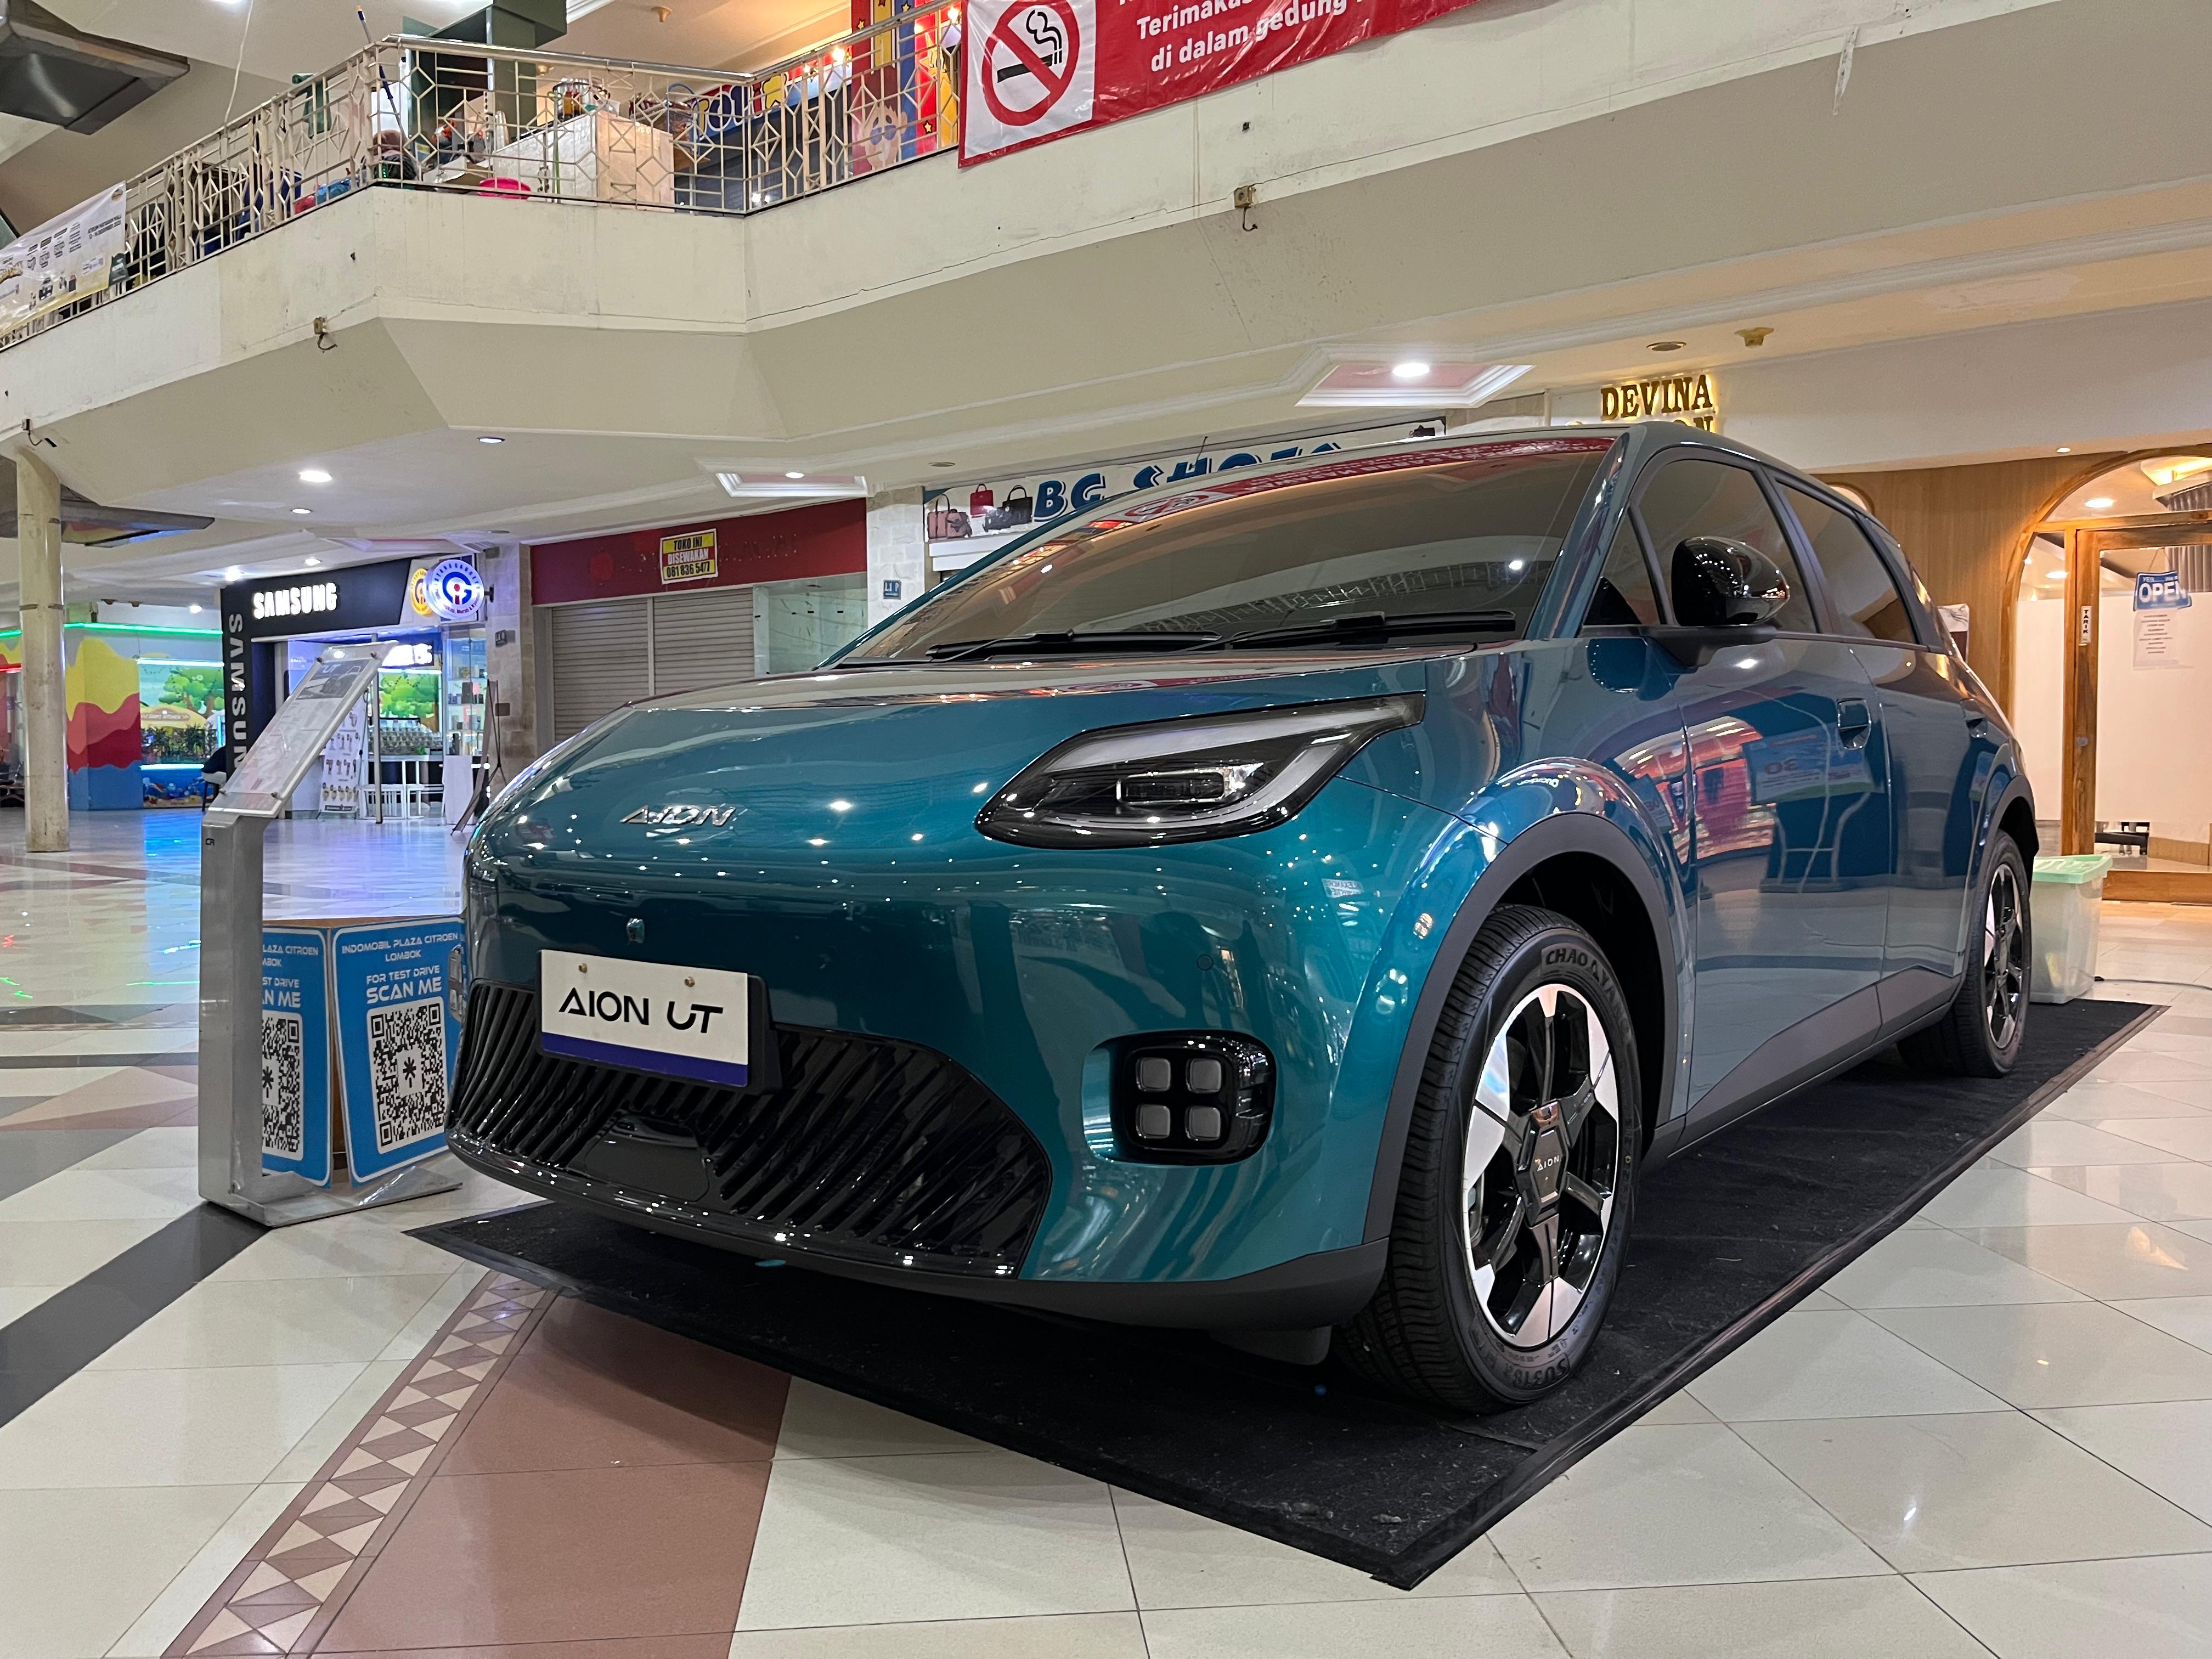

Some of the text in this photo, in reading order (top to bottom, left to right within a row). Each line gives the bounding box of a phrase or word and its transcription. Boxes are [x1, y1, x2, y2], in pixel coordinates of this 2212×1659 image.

[1151, 0, 1347, 72] di dalam gedung
[1601, 374, 1713, 421] DEVINA
[1034, 473, 1104, 520] BG
[674, 536, 703, 551] TOKO INI
[668, 548, 709, 565] DISEWAKAN
[667, 566, 679, 578] 081
[680, 563, 694, 575] 836
[253, 582, 337, 619] SAMSUNG
[2139, 581, 2186, 603] OPEN
[229, 613, 247, 768] SAMSUN
[619, 804, 736, 827] AION
[263, 944, 318, 956] LAZA CITROEN
[342, 933, 458, 954] INDOMOBIL PLAZA CITROEN
[385, 949, 421, 962] LOMBOK
[262, 977, 300, 988] ST DRIVE
[366, 964, 440, 985] FOR TEST DRIVE
[278, 991, 301, 1008] ME
[366, 976, 442, 1005] SCAN ME
[558, 987, 724, 1034] AION UT
[1537, 1155, 1559, 1172] AION
